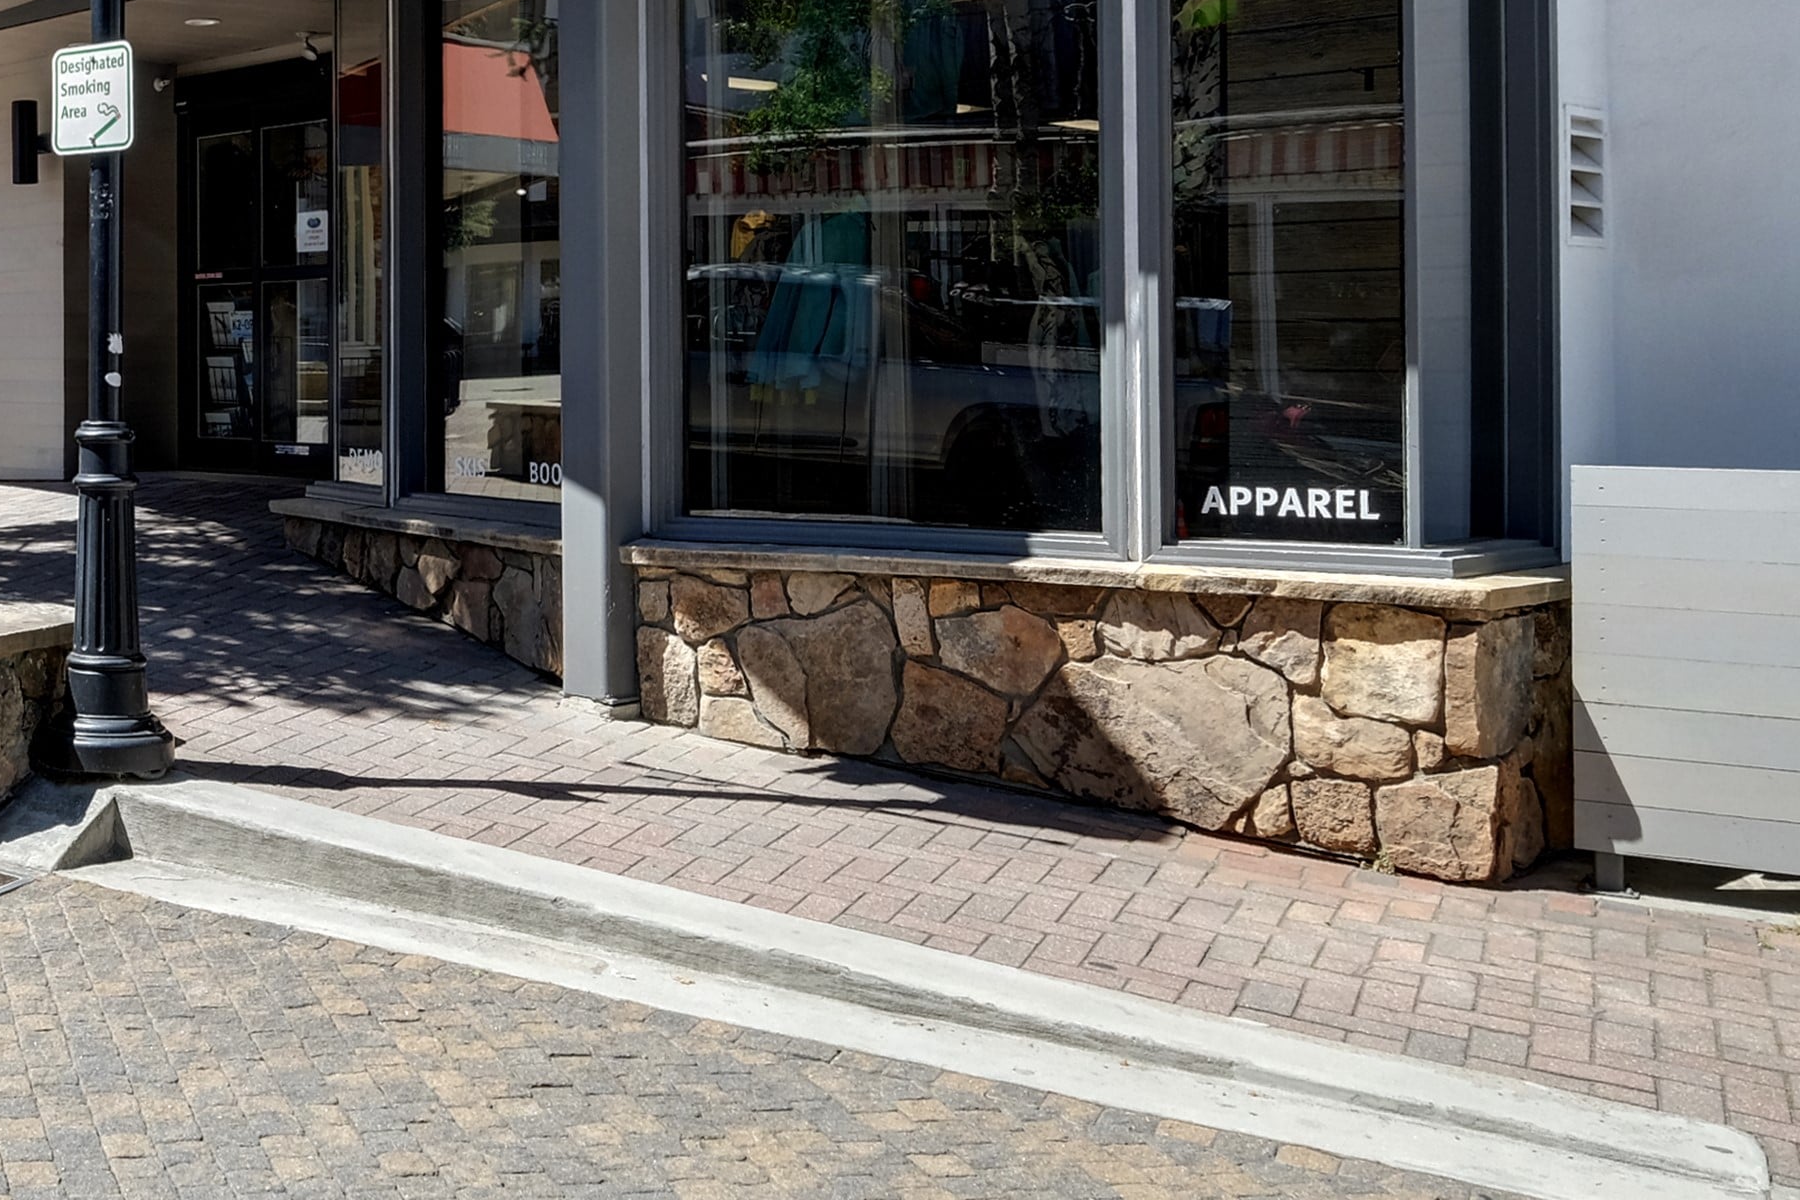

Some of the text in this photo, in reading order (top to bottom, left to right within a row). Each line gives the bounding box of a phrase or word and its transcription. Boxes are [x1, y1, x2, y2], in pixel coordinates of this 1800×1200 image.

[60, 51, 125, 75] Designated
[60, 79, 111, 97] Smoking
[60, 105, 87, 119] Area
[454, 456, 487, 477] SKIS
[1201, 486, 1380, 520] APPAREL
